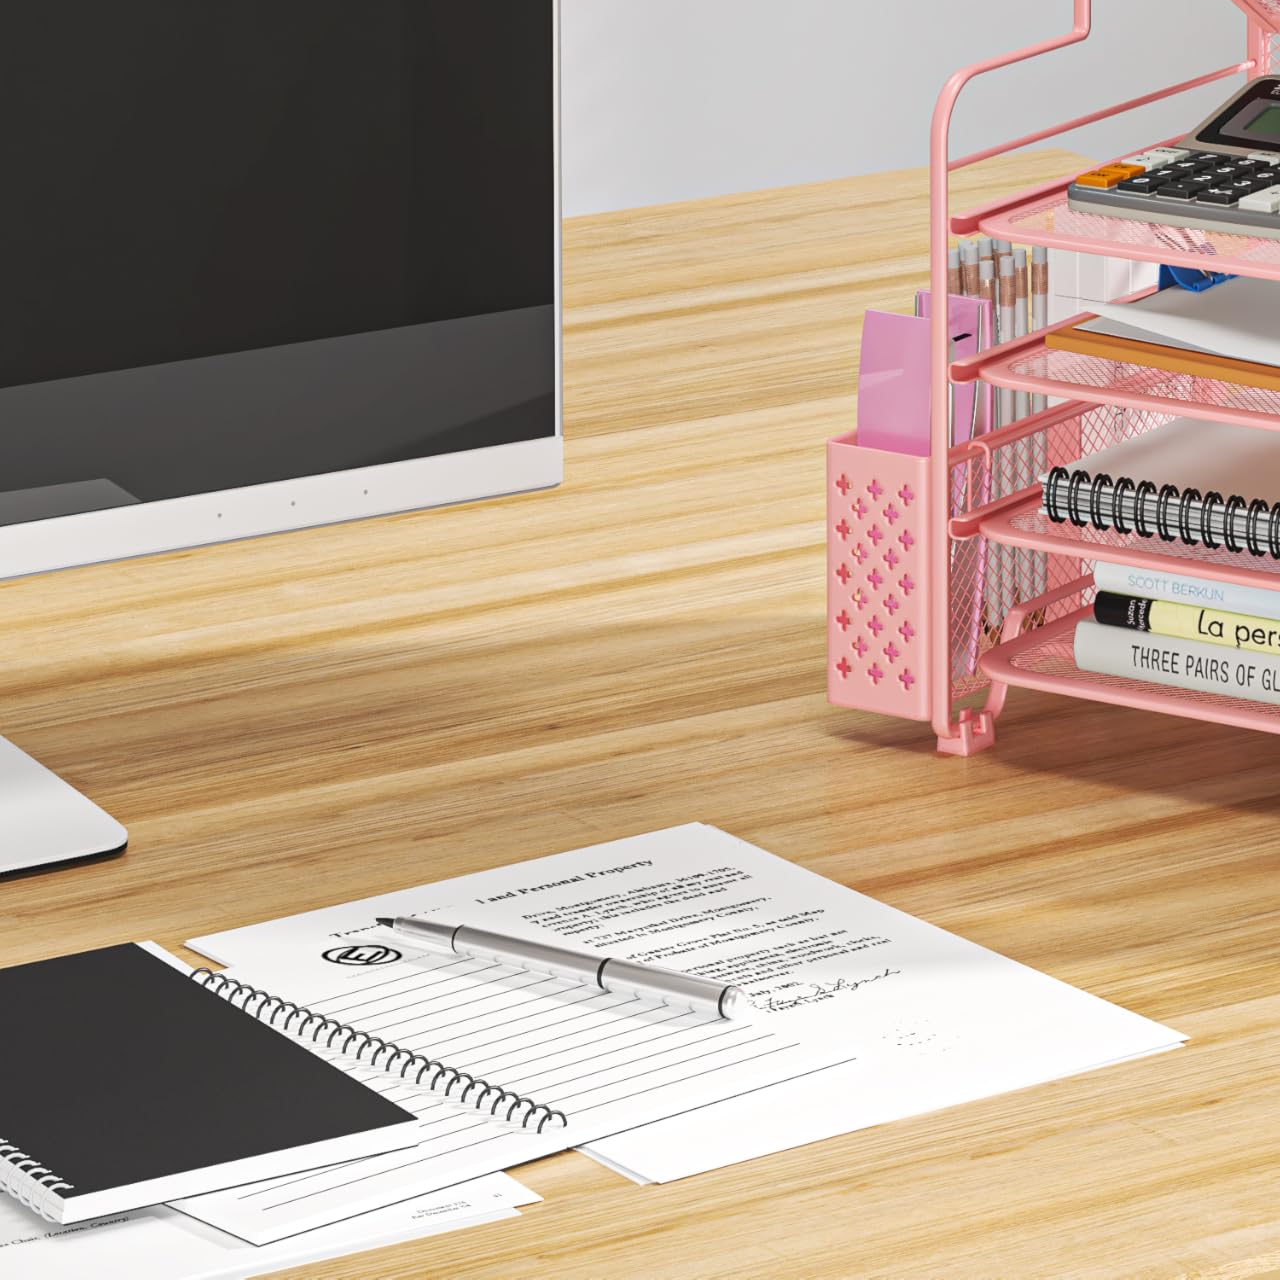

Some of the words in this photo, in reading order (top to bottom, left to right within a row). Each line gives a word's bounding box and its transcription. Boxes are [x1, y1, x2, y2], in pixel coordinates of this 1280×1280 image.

[1128, 574, 1168, 592] SCOTT
[1172, 582, 1225, 602] BERKUN
[1198, 609, 1224, 638] La
[1131, 645, 1180, 675] THREE
[1186, 655, 1230, 684] PAIRS
[1235, 663, 1256, 687] OF
[487, 892, 517, 902] and
[517, 876, 586, 895] Personal
[584, 860, 653, 878] Property
